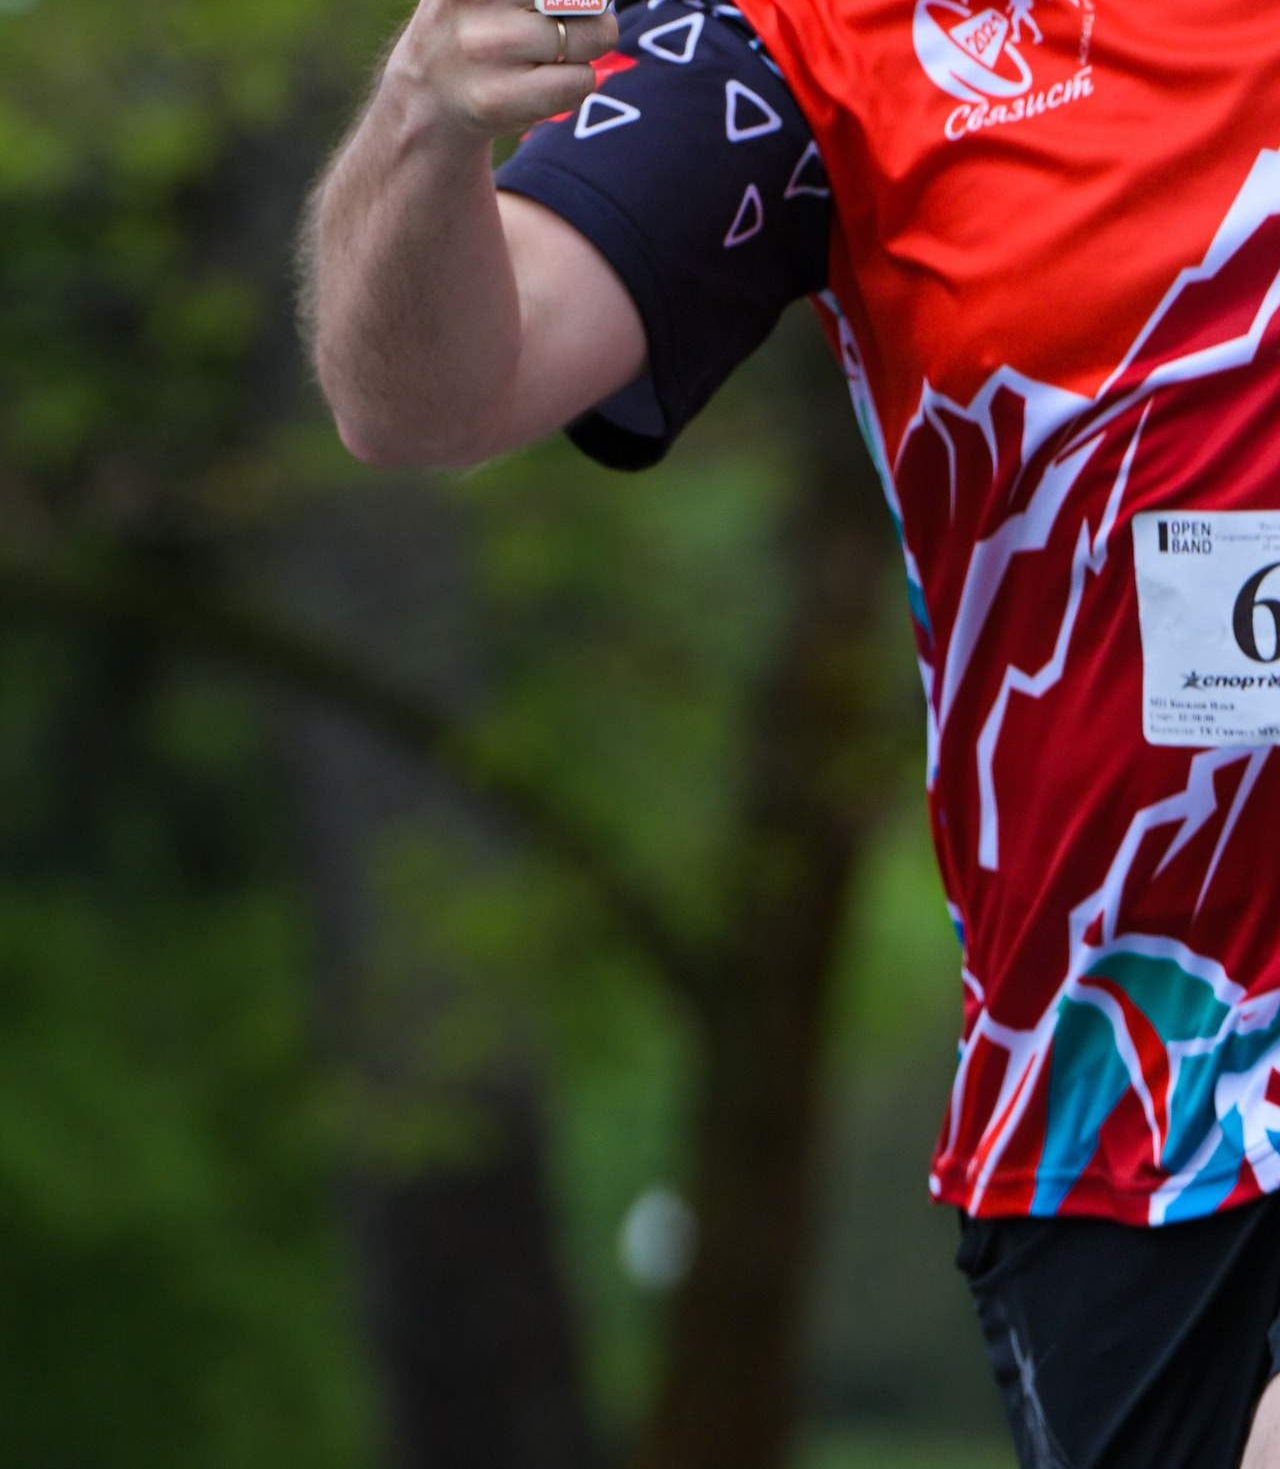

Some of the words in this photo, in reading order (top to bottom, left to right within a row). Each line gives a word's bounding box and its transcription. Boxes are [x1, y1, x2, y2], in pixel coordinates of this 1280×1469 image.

[944, 65, 1094, 141] Связист
[1171, 521, 1211, 536] OPEN
[1171, 539, 1213, 554] BAND
